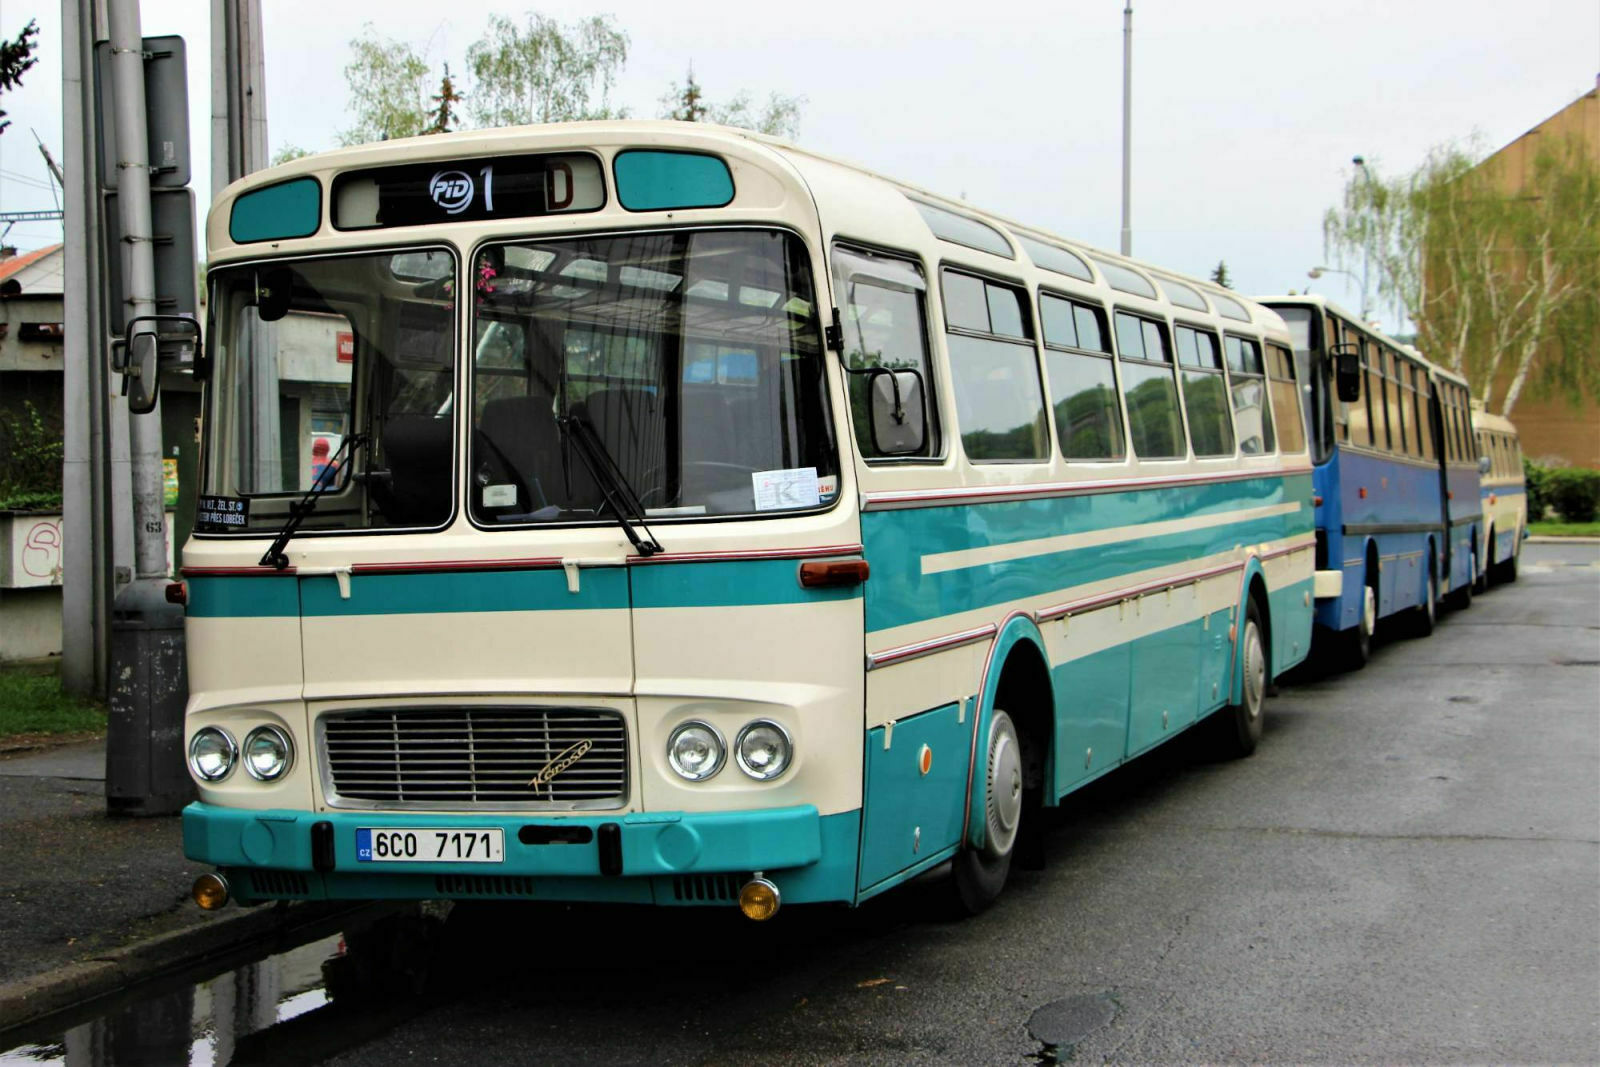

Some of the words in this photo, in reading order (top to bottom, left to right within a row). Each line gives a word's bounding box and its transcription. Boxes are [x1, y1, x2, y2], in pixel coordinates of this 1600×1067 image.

[480, 164, 494, 212] 1
[547, 161, 574, 211] D
[145, 521, 162, 534] 63
[359, 848, 371, 857] CZ
[435, 832, 491, 858] 7171
